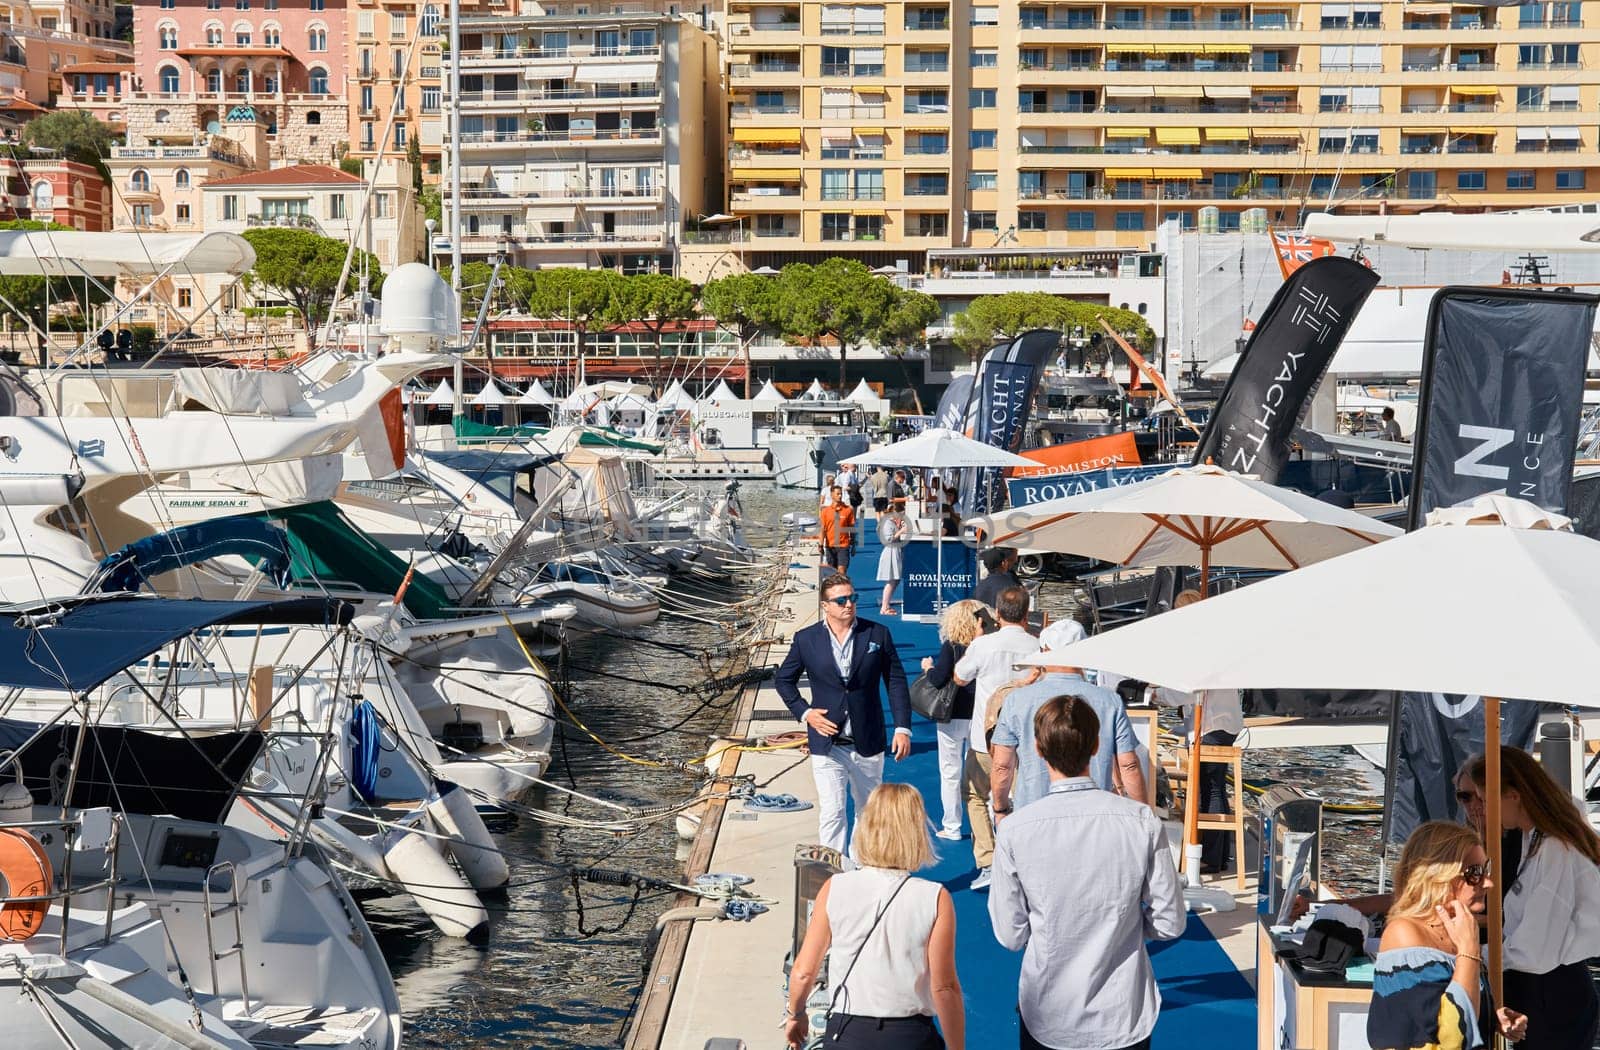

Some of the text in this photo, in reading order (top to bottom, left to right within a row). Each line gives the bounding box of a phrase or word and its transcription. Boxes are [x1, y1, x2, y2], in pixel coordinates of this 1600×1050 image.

[1036, 453, 1125, 476] EDMISTON
[1024, 480, 1100, 504] ROYAL
[909, 573, 972, 582] ROYAL YACHT
